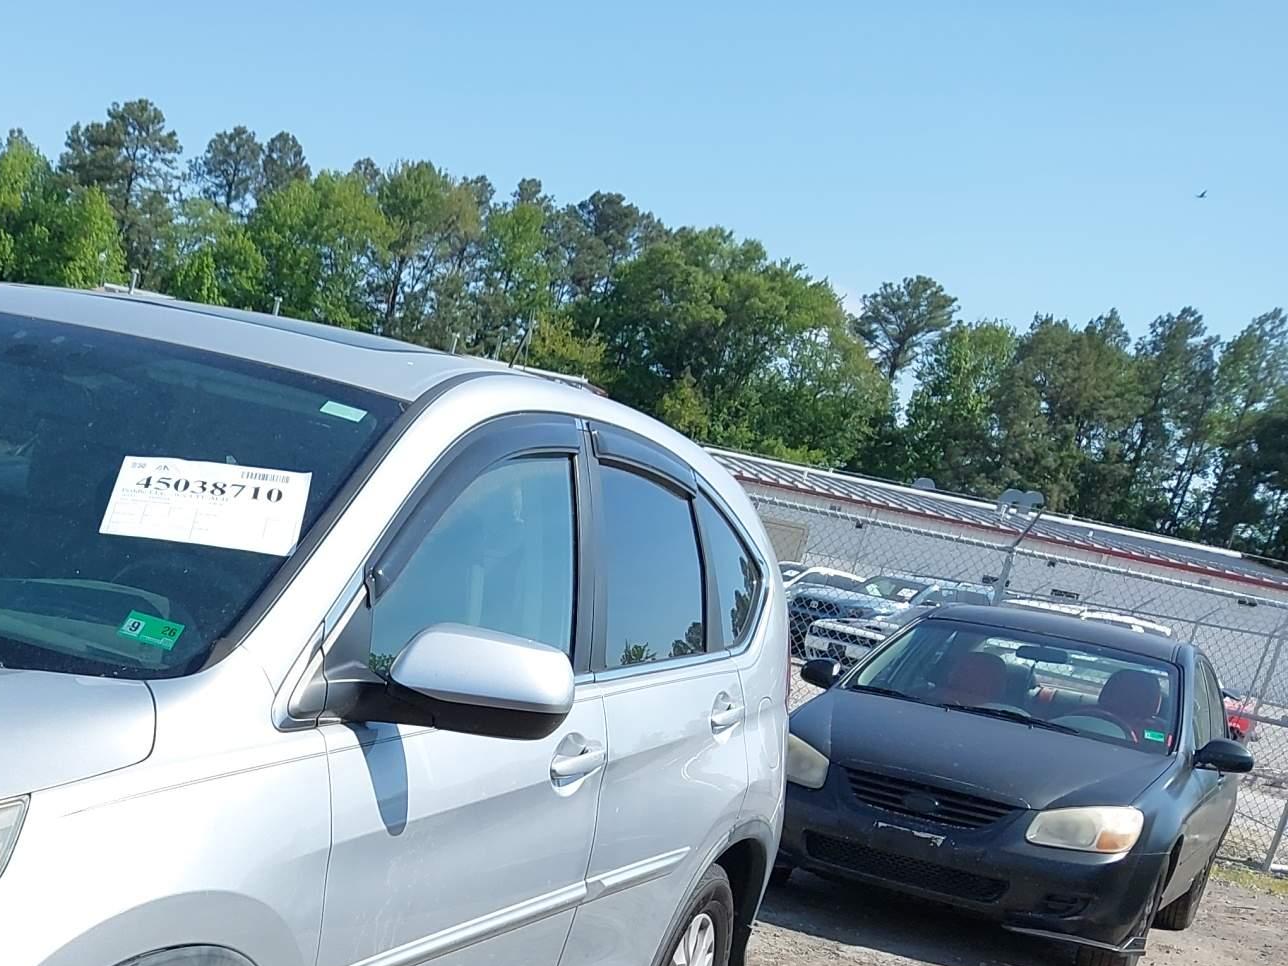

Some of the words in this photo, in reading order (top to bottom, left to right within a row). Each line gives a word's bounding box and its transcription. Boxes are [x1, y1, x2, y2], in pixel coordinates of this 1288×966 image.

[136, 476, 283, 503] 45038710
[128, 621, 141, 633] 9
[161, 626, 178, 638] 26
